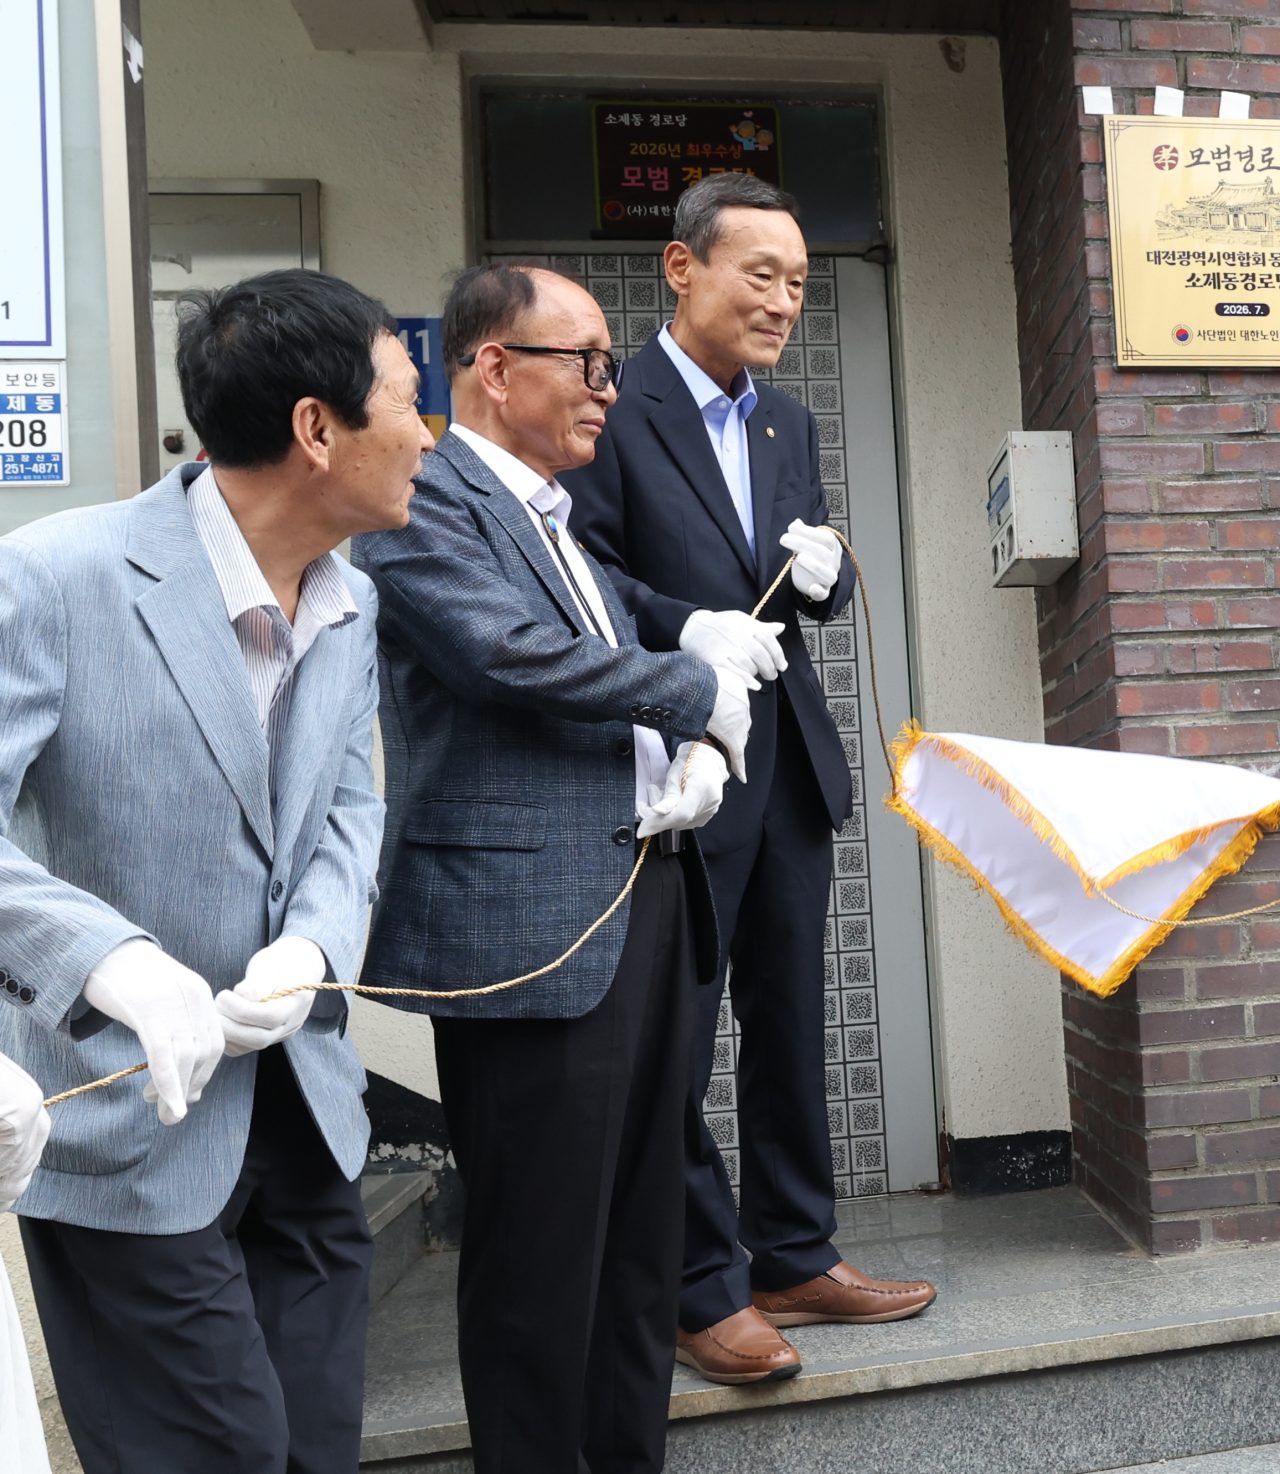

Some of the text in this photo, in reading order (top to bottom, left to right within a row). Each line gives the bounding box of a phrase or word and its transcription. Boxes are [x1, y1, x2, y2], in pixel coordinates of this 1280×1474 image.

[604, 113, 688, 127] 소제동 경로당
[629, 142, 742, 160] 2026년 최우수상
[621, 166, 670, 192] 모범
[1223, 305, 1264, 315] 2026. 7.
[1197, 329, 1237, 342] 사단법인
[5, 373, 56, 387] 보안등
[0, 419, 47, 448] 08
[4, 463, 59, 474] 251-4871
